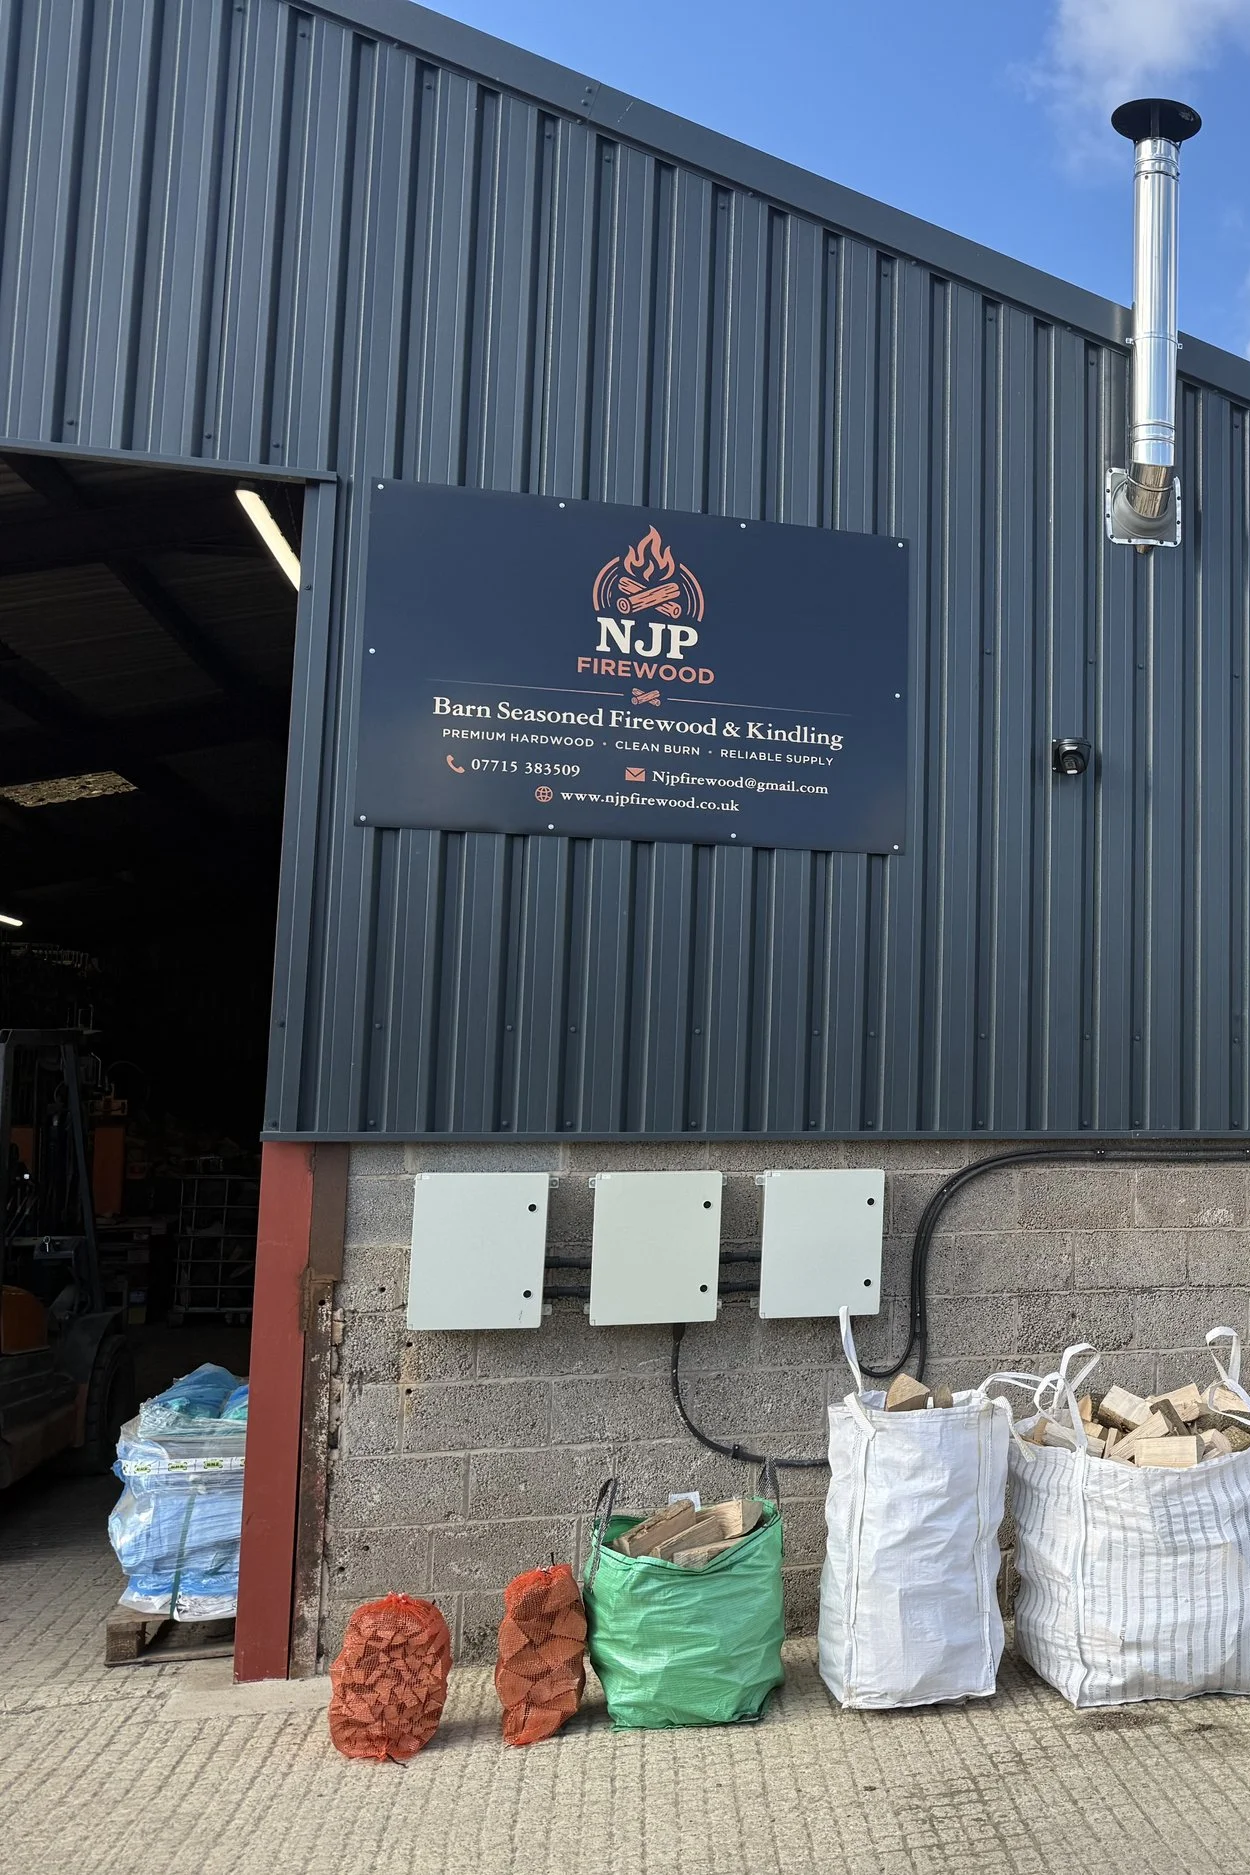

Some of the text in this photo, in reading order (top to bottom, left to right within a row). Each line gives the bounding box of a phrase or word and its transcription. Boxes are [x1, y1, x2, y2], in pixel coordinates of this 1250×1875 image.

[595, 616, 699, 660] NJP
[577, 656, 715, 685] FIREWOOD
[432, 696, 844, 751] Barn Seasoned Firewood & Kindling
[442, 728, 834, 767] PREMIUM HARDWOOD CLEAN BURN RELIABLE SUPPLY
[470, 758, 581, 778] 07715 383509
[651, 770, 829, 795] Njpfirewood@gmail.com
[560, 791, 740, 812] www.njpfirewood.co.uk
